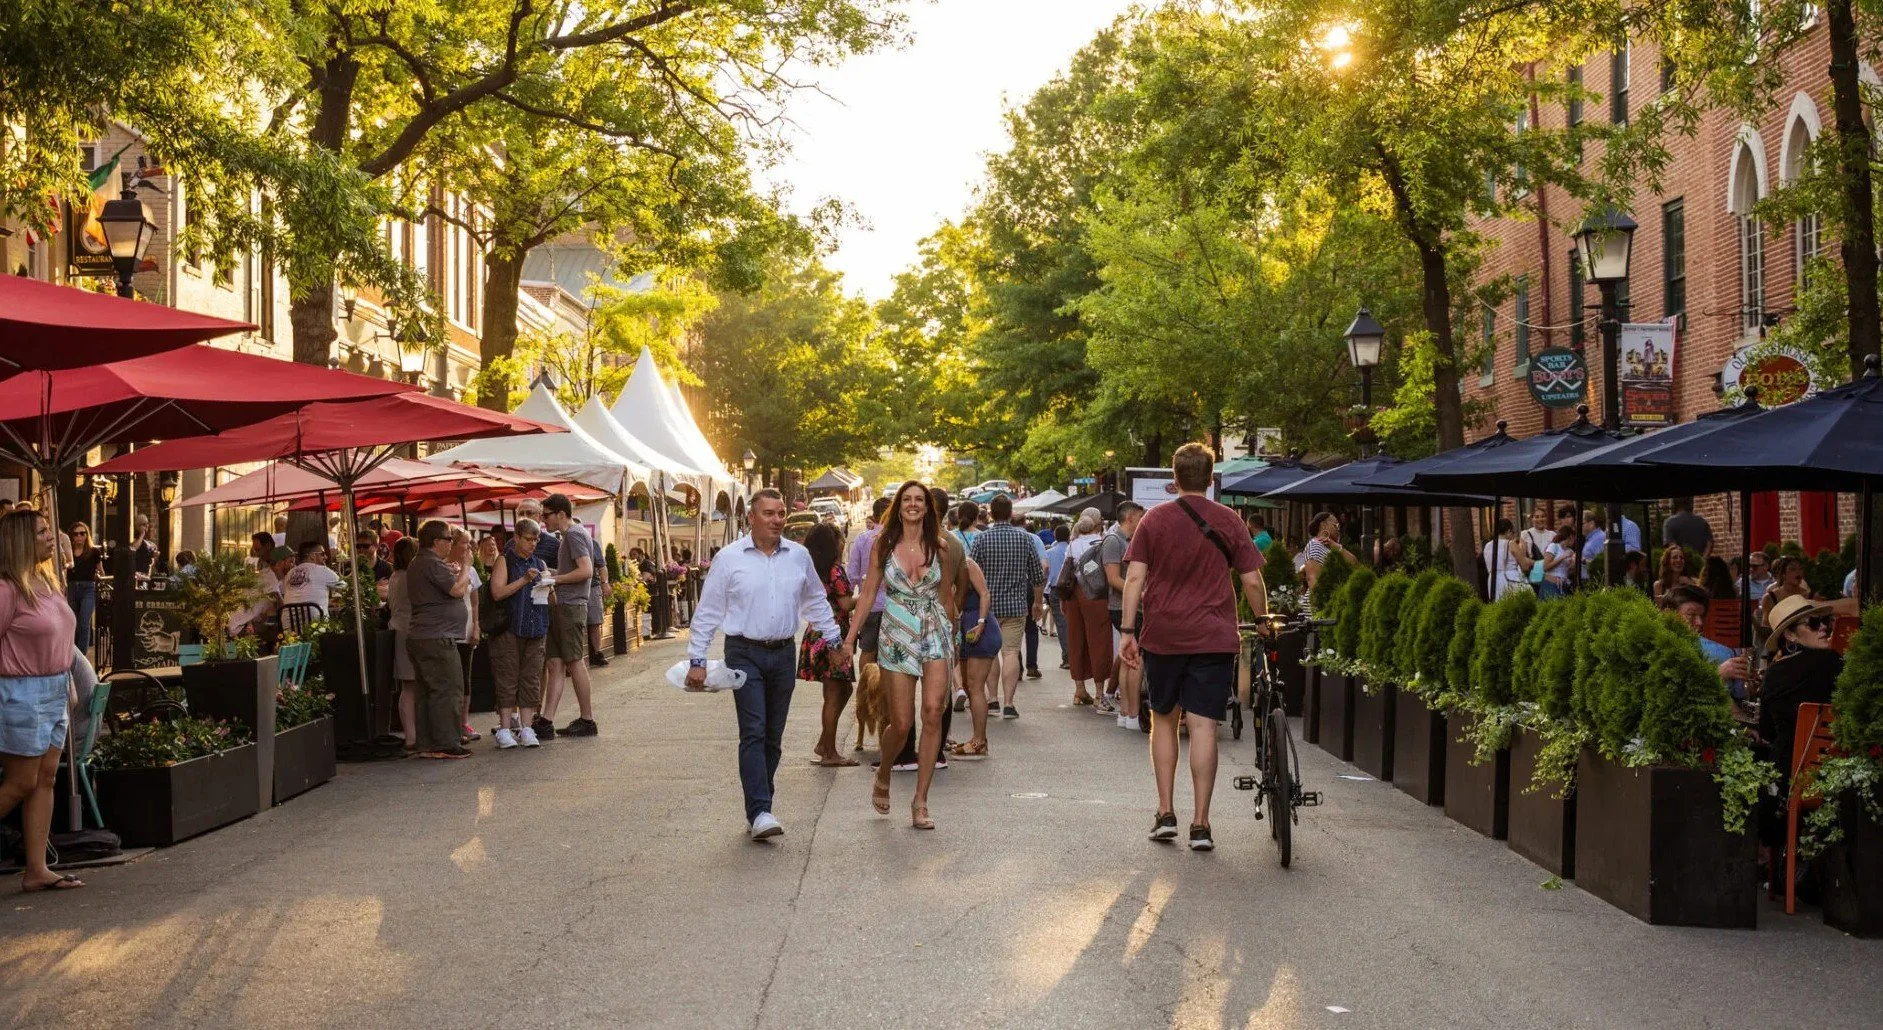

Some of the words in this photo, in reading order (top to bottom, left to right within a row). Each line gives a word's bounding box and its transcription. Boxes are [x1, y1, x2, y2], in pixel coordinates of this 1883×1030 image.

[75, 255, 113, 263] RESTAURAN
[1540, 354, 1573, 363] SPORTS
[1547, 361, 1567, 369] BAR
[1541, 392, 1579, 400] UPSTAIRS
